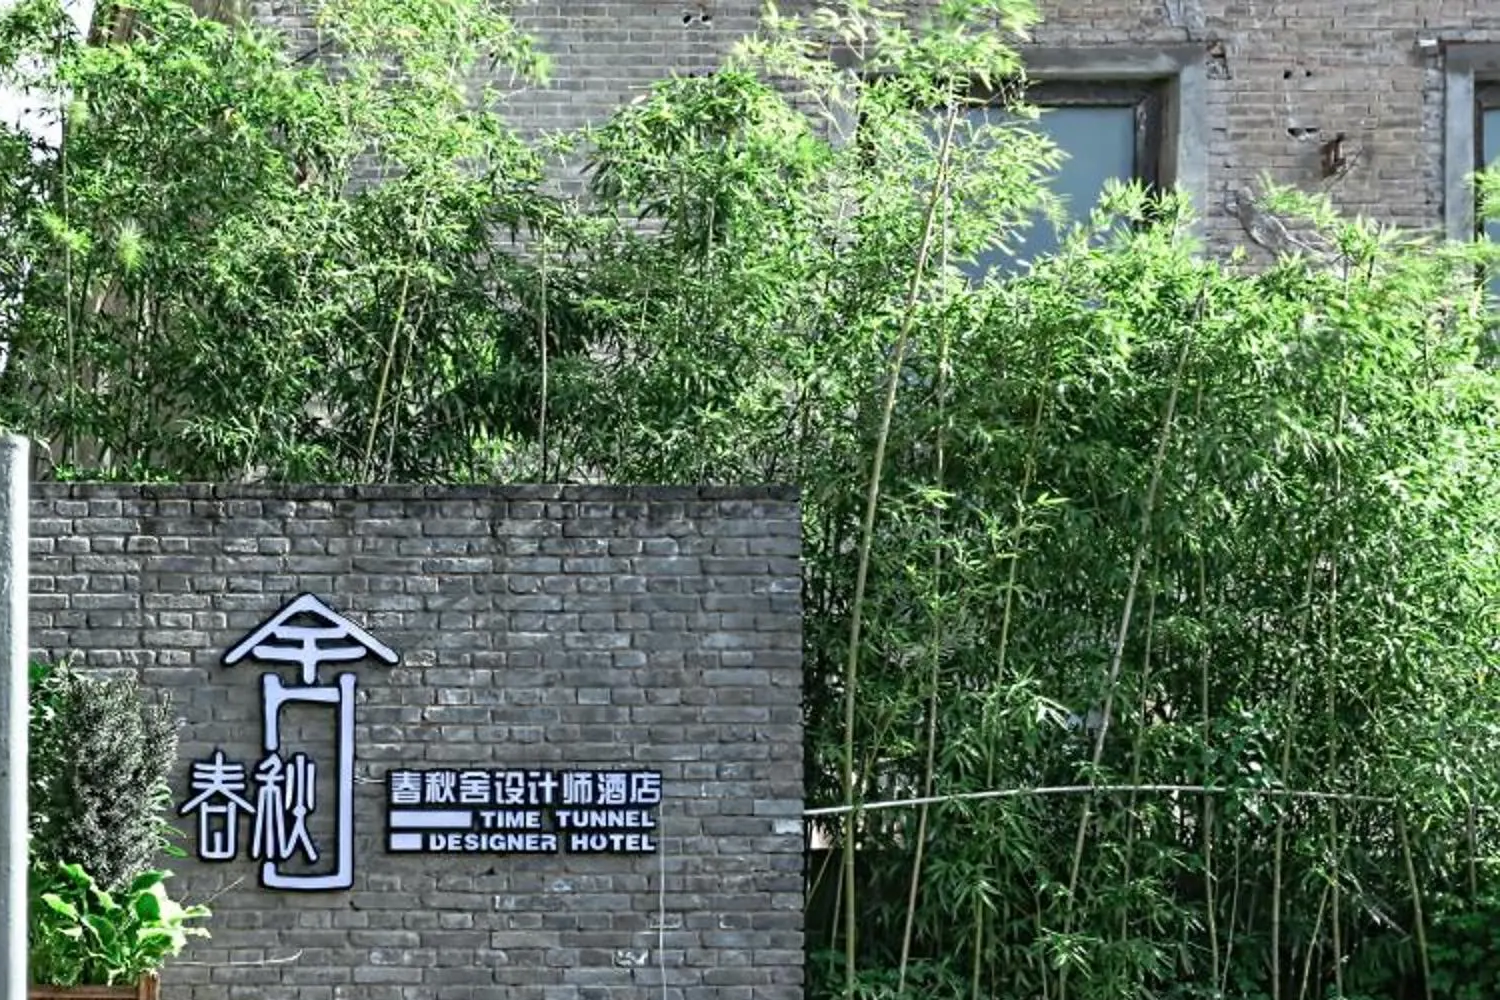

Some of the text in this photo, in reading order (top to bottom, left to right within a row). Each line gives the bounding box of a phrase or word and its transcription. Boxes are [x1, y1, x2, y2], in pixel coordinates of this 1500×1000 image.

[391, 771, 661, 805] 春秋舍设计师酒店
[180, 750, 318, 862] 春秋
[480, 811, 655, 828] TIME TUNNEL
[429, 833, 656, 851] DESIGNER HOTEL
